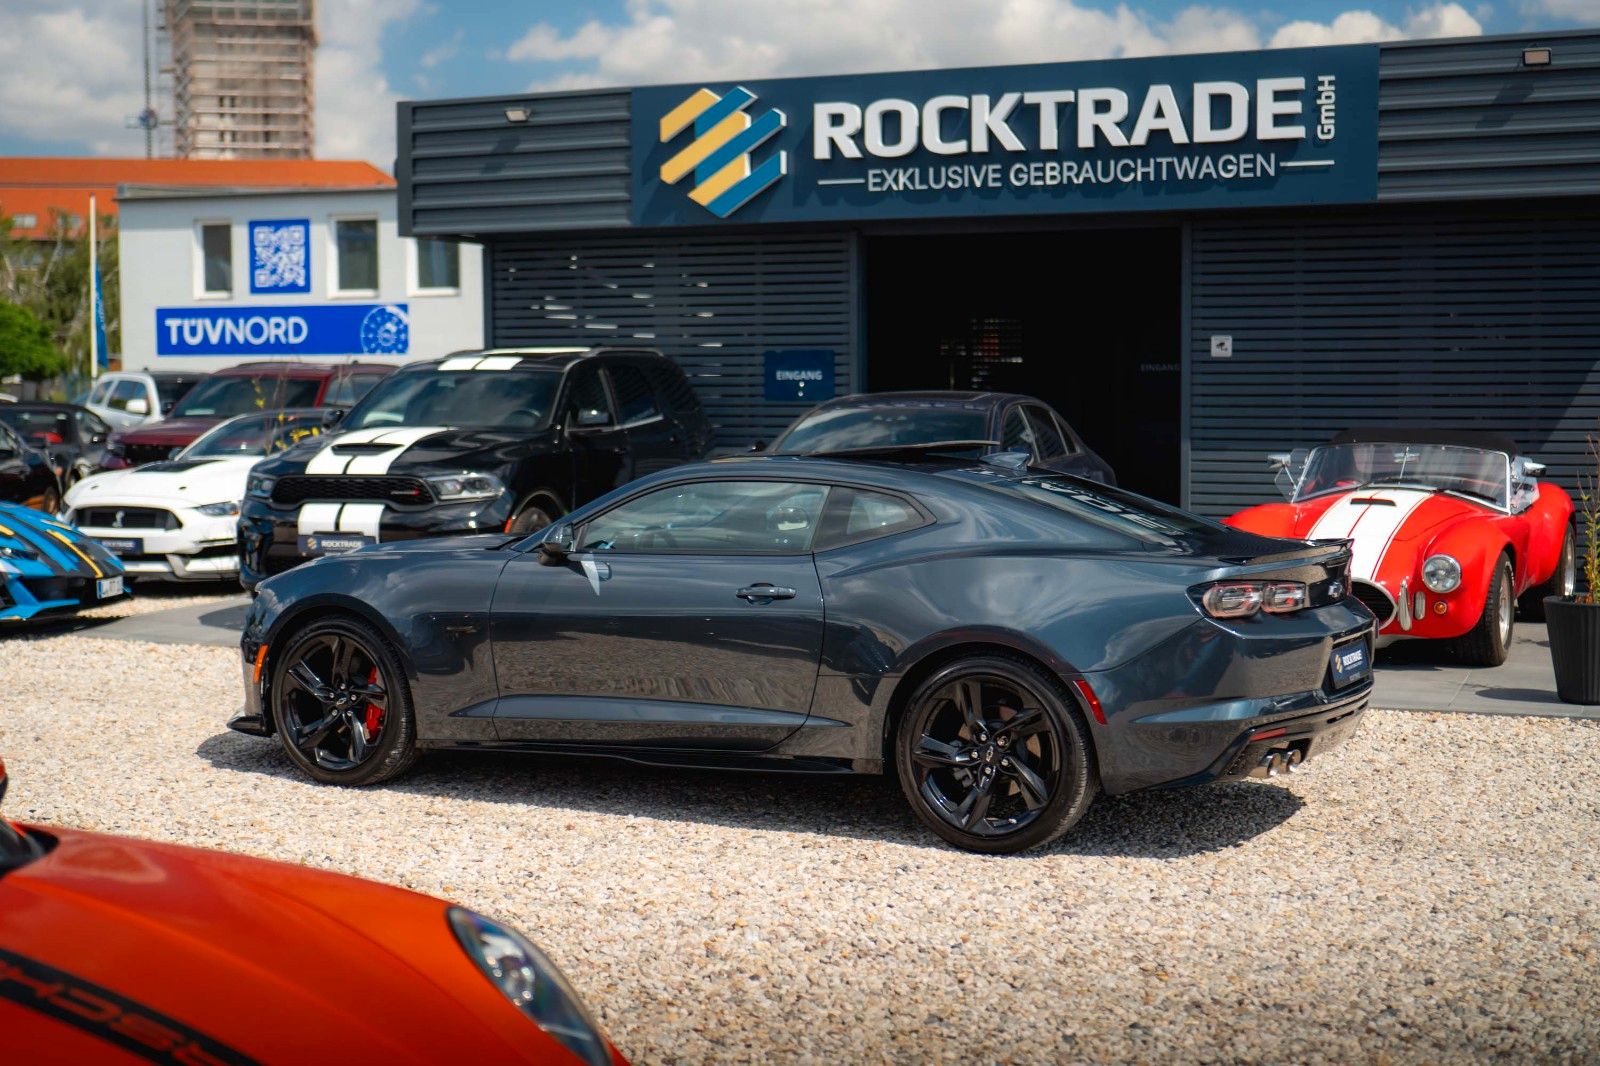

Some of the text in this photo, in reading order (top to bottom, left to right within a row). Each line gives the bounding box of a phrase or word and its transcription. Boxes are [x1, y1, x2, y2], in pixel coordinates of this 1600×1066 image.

[812, 77, 1306, 160] ROCKTRADE
[1316, 75, 1336, 140] GmbH
[867, 153, 1276, 192] EXKLUSIVE GEBRAUCHTWAGEN
[775, 370, 823, 381] EINGANG
